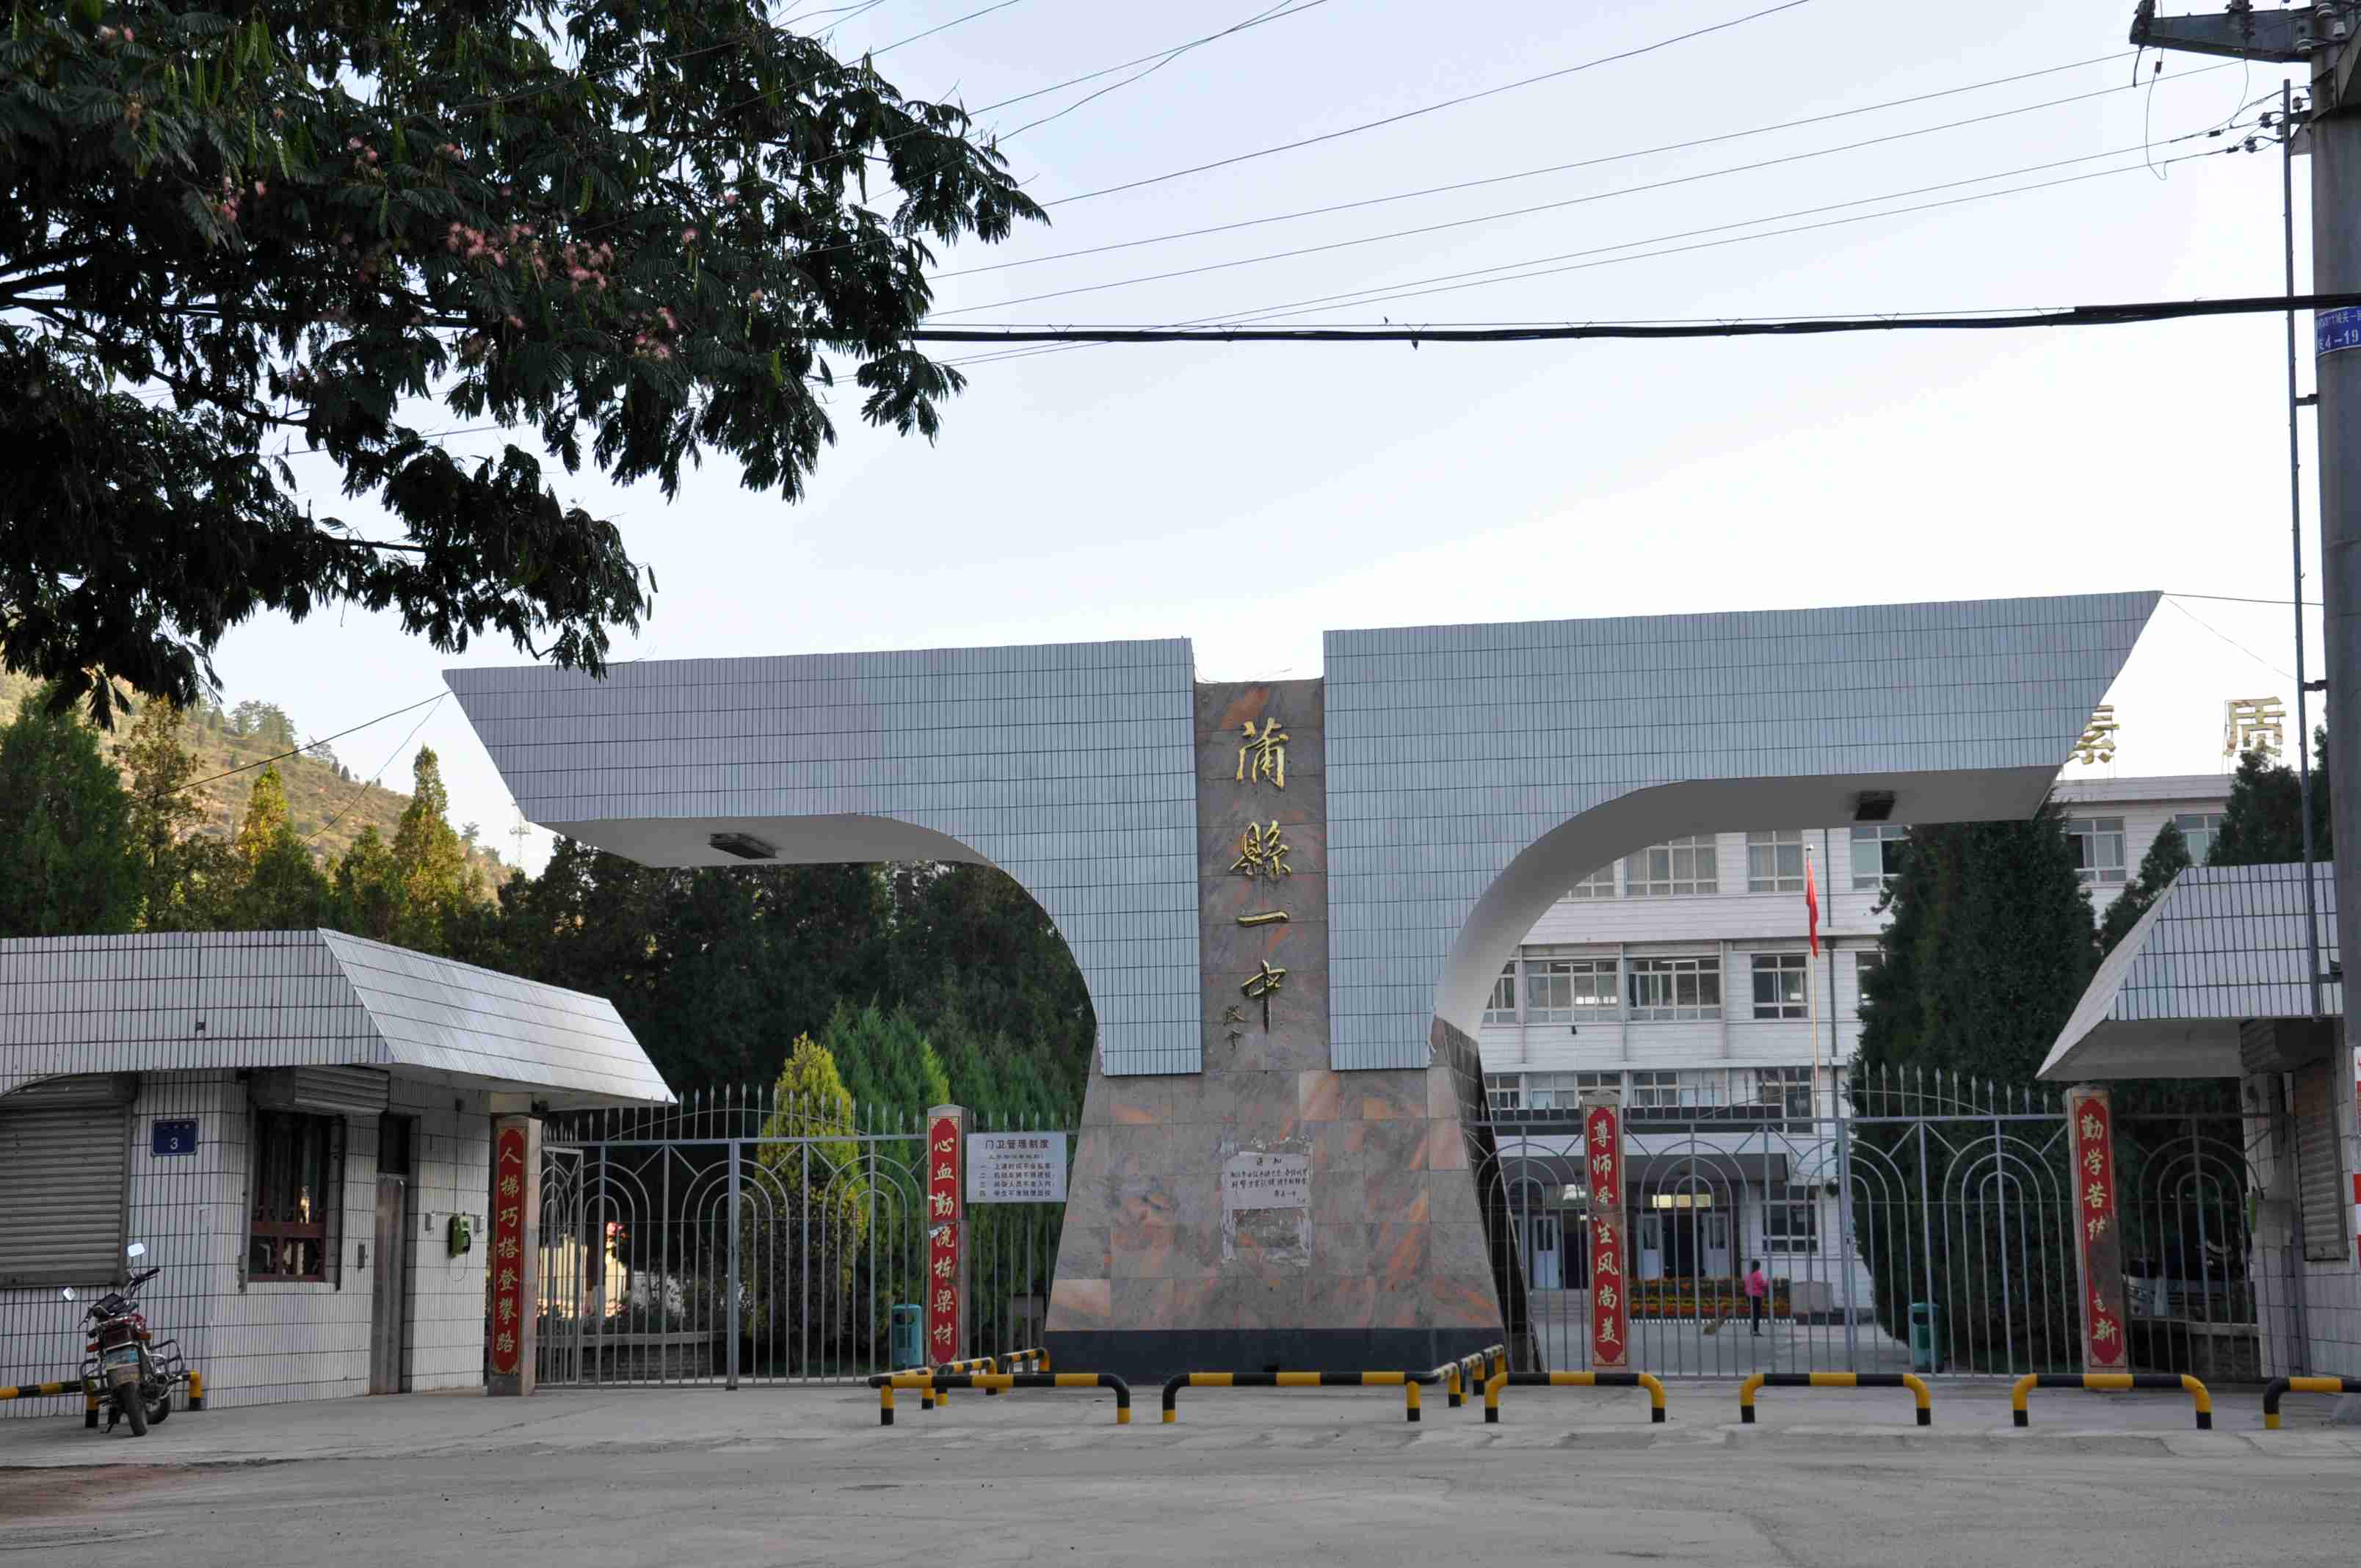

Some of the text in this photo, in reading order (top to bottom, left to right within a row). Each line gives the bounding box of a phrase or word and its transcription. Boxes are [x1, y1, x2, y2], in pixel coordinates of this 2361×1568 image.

[170, 1137, 178, 1150] 3
[984, 1139, 1049, 1150] 门卫管理制度
[496, 1147, 522, 1354] 人梯巧搭登攀路
